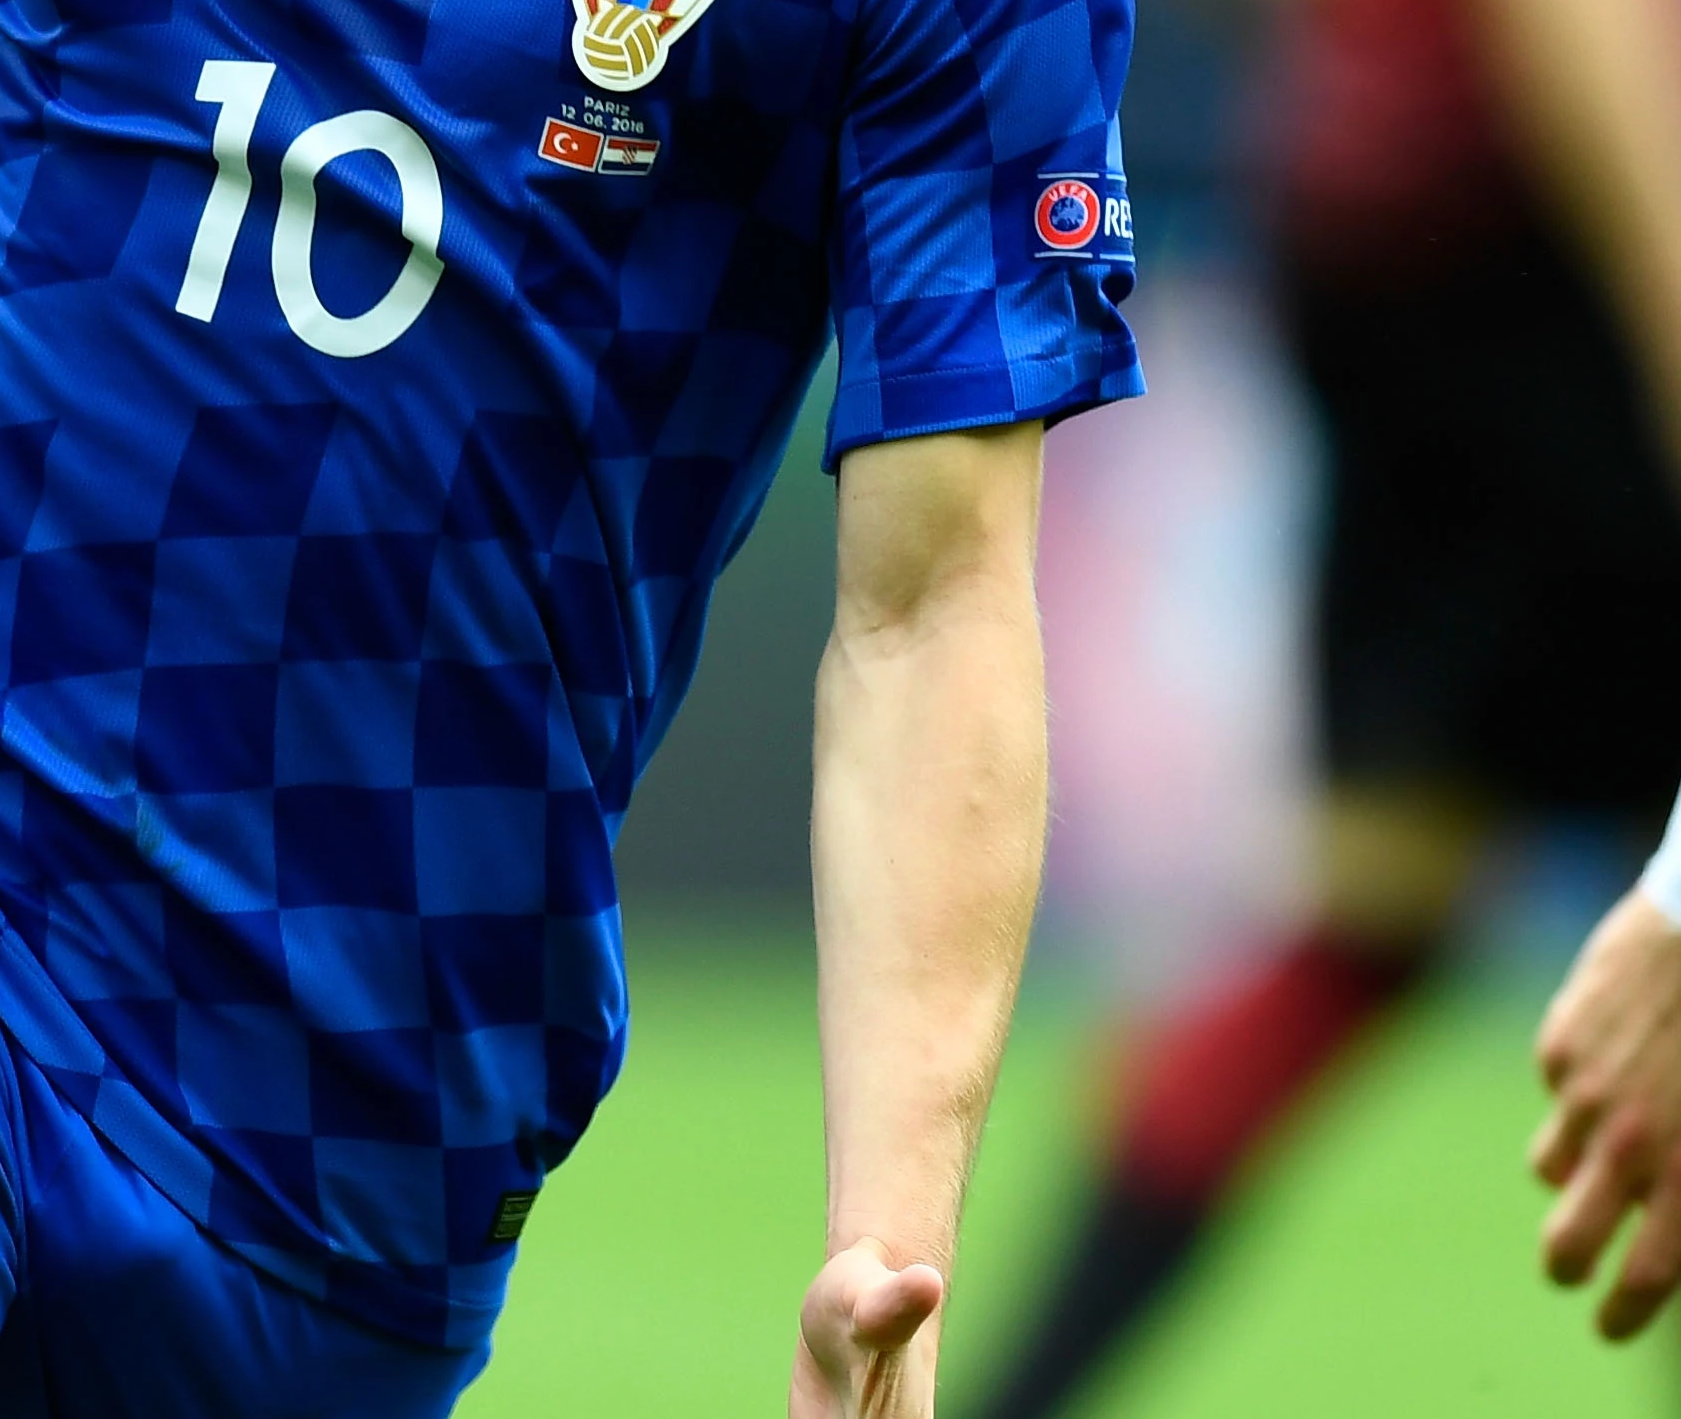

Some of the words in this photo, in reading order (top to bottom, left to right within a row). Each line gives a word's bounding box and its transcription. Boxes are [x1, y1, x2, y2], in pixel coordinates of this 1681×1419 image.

[584, 96, 630, 116] PARIZ
[1048, 185, 1088, 202] UEFA
[175, 59, 446, 359] 10
[1104, 198, 1134, 239] RE
